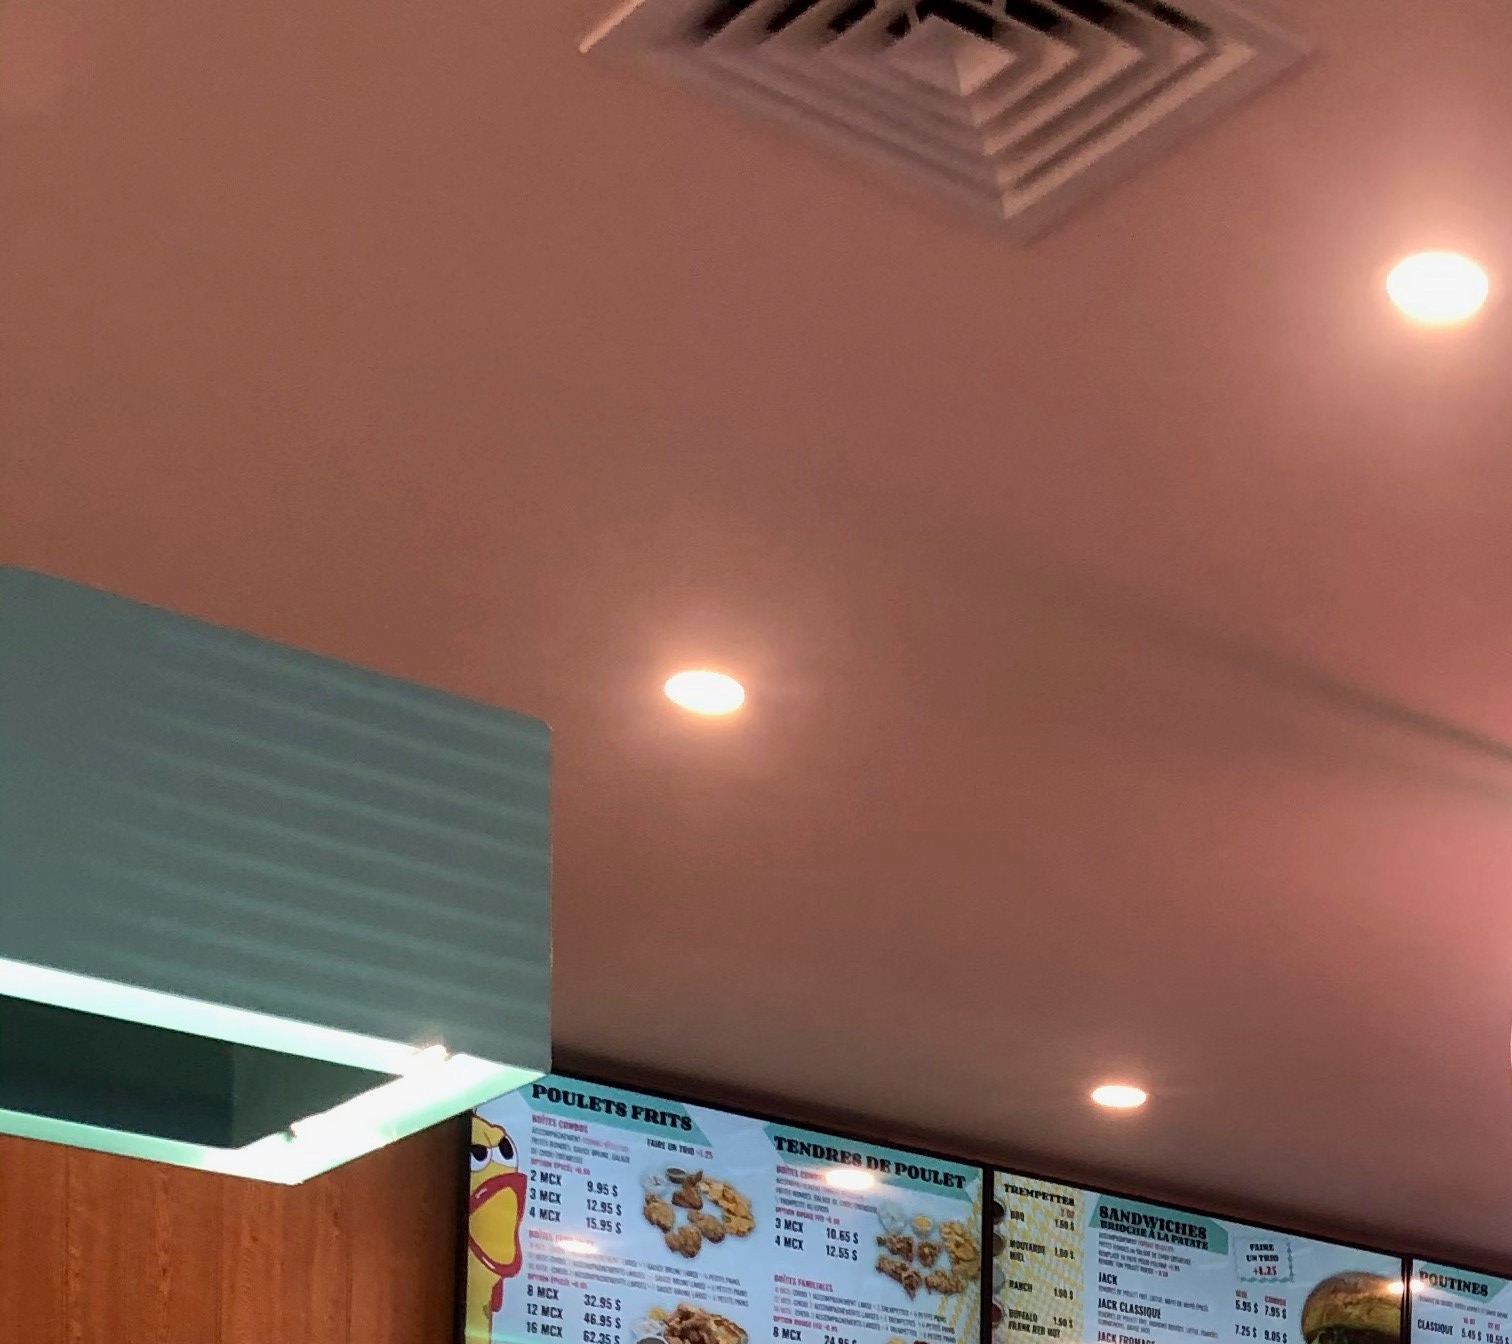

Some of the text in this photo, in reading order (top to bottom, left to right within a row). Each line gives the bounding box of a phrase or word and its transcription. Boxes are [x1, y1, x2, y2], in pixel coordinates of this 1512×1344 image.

[532, 1083, 692, 1131] POULETS FRITS
[679, 1144, 695, 1155] TRIO
[774, 1135, 967, 1190] TENDRES DE POULET
[530, 1169, 562, 1187] 2 MCX
[587, 1180, 610, 1196] 9.95
[530, 1188, 562, 1205] 3 MCX
[529, 1206, 561, 1223] 4 MCX
[586, 1199, 614, 1215] 12.95
[586, 1217, 613, 1233] 15.95
[775, 1217, 804, 1234] 3 MCX
[1099, 1205, 1207, 1240] SANDWICHES
[826, 1227, 850, 1242] 10.65
[1100, 1220, 1148, 1237] BRIOCHE
[1158, 1231, 1169, 1242] LA
[1171, 1234, 1209, 1251] PATATE
[774, 1235, 804, 1251] 4 MCX
[826, 1244, 850, 1259] 12.55
[1098, 1272, 1118, 1286] JACK
[1419, 1270, 1489, 1298] POUTINES
[527, 1285, 560, 1301] 8 MCX
[584, 1294, 613, 1310] 32.95
[1098, 1298, 1161, 1320] JACK CLASSIQUE
[1235, 1299, 1251, 1313] 5.95
[527, 1303, 563, 1320] 12 MCX
[1265, 1305, 1280, 1318] 7.95
[583, 1312, 612, 1328] 46.95
[1417, 1318, 1454, 1336] CLASSIQUE
[526, 1321, 563, 1339] 16 MCX
[773, 1326, 802, 1342] 8 MCX
[1098, 1331, 1116, 1344] JACK
[1235, 1324, 1251, 1337] 7.25
[1264, 1329, 1281, 1343] 9.05
[1461, 1328, 1476, 1340] 5.45
